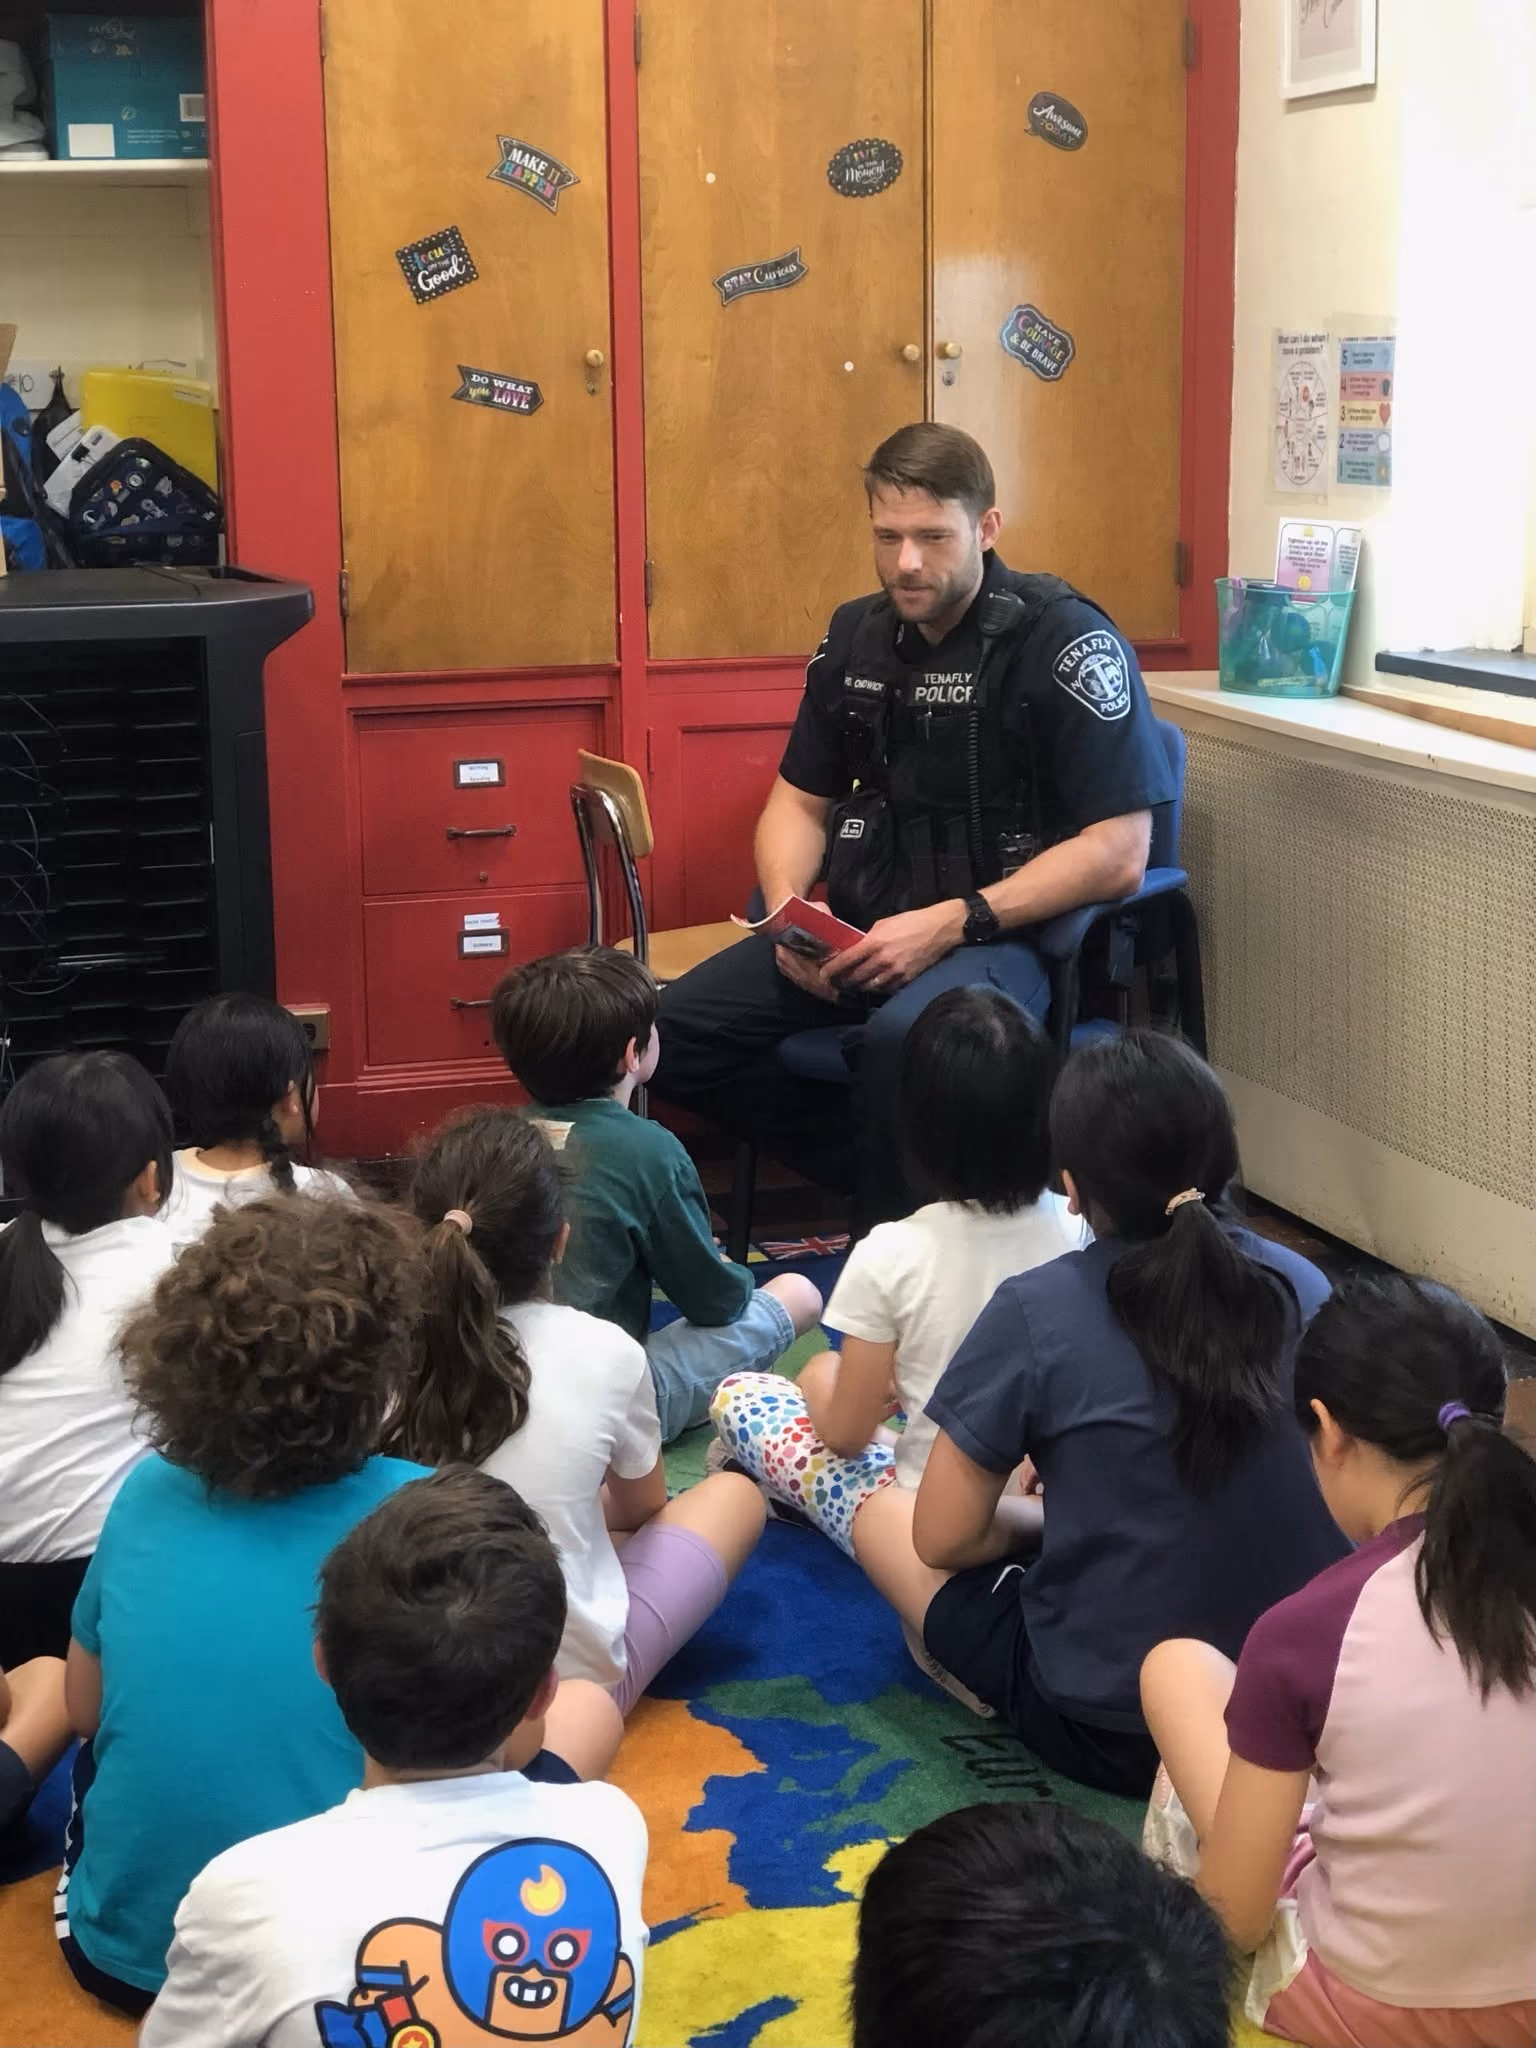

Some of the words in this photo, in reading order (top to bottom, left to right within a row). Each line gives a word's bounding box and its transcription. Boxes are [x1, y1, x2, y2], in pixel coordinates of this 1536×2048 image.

[502, 161, 556, 198] HAPPEN
[507, 147, 548, 176] MAKE
[547, 168, 561, 185] IT
[417, 254, 466, 291] Good
[724, 271, 752, 292] STAY
[753, 263, 798, 284] Curious
[1034, 322, 1062, 346] HAVE
[1020, 339, 1032, 353] BE
[1031, 348, 1059, 373] BRAVE
[1342, 350, 1348, 366] 5
[469, 387, 491, 399] you
[492, 388, 531, 409] LOVE
[471, 374, 489, 384] DO
[492, 379, 534, 394] WHAT
[1339, 433, 1345, 449] 2
[1058, 638, 1112, 673] TENAFLY
[923, 673, 973, 684] TENAFLY
[940, 1733, 1054, 1798] Eur
